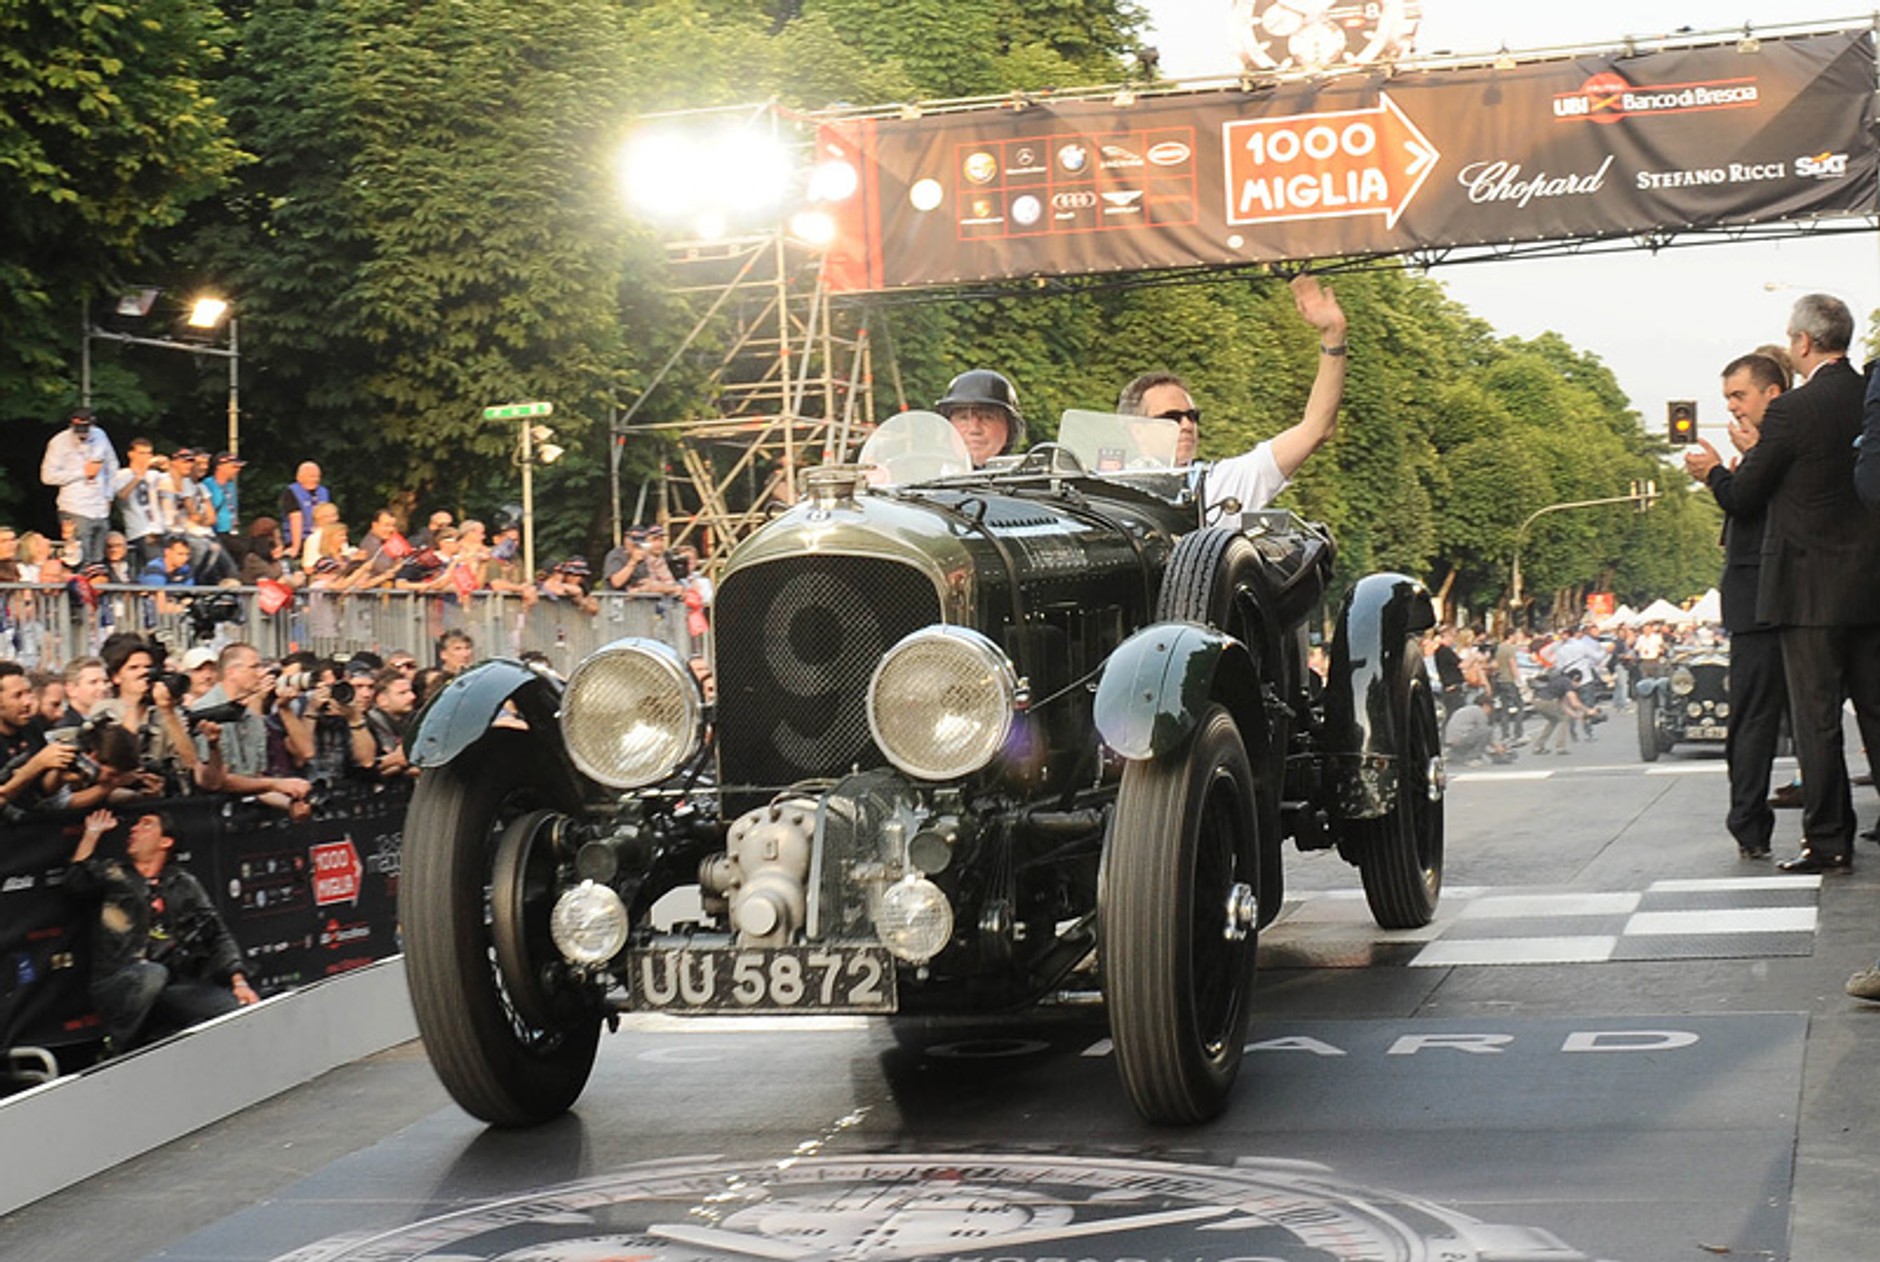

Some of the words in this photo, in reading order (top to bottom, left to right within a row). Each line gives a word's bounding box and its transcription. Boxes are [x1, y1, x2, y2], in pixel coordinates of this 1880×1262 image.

[1554, 96, 1589, 116] UBI
[1623, 94, 1678, 110] Banco
[1679, 88, 1694, 106] di
[1695, 86, 1757, 105] Brescia
[1246, 122, 1376, 165] 1000
[1239, 168, 1389, 213] MIGLIA
[1457, 154, 1615, 209] Chopard
[1637, 170, 1726, 190] STEFANO
[1728, 163, 1786, 182] RICCI
[642, 950, 716, 1005] UU
[732, 951, 884, 1005] 5872
